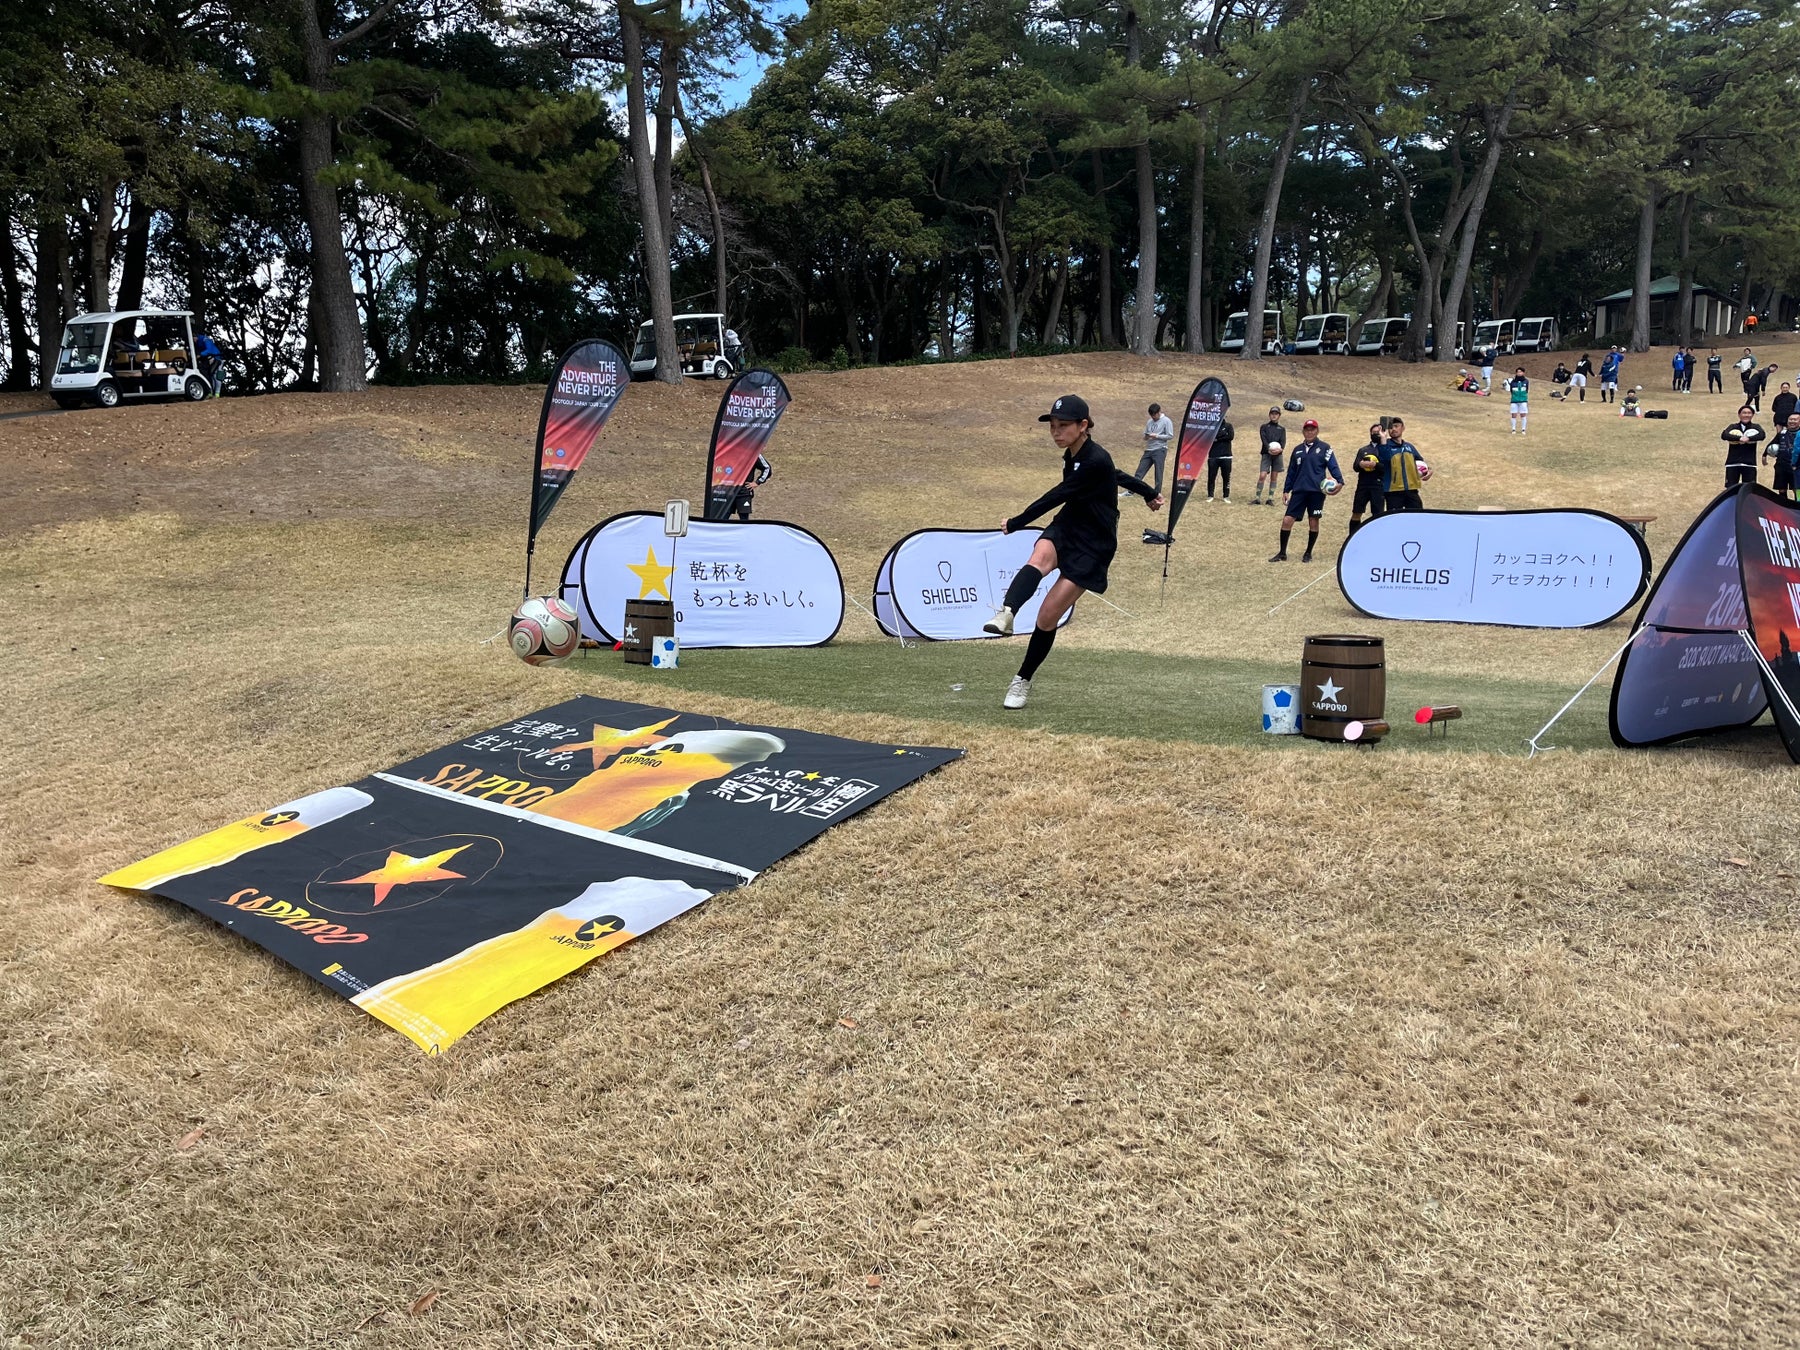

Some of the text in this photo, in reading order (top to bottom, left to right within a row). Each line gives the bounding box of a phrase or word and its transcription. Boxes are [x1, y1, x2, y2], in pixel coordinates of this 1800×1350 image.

[598, 361, 617, 373] THE
[560, 369, 617, 385] ADVENTURE
[558, 381, 617, 397] NEVER ENDS
[761, 386, 777, 397] THE
[728, 394, 777, 408] ADVENTURE
[726, 405, 776, 419] NEVER ENDS
[1189, 409, 1221, 422] NEVER ENDS
[670, 505, 676, 530] 1
[1758, 516, 1791, 567] THE
[689, 560, 747, 582] 乾杯を
[1370, 567, 1450, 585] SHIELDS
[693, 588, 814, 608] もっとおいしく。
[921, 587, 978, 605] SHIELDS
[1312, 701, 1348, 712] SAPPORO
[706, 778, 808, 814] 黒ラベル
